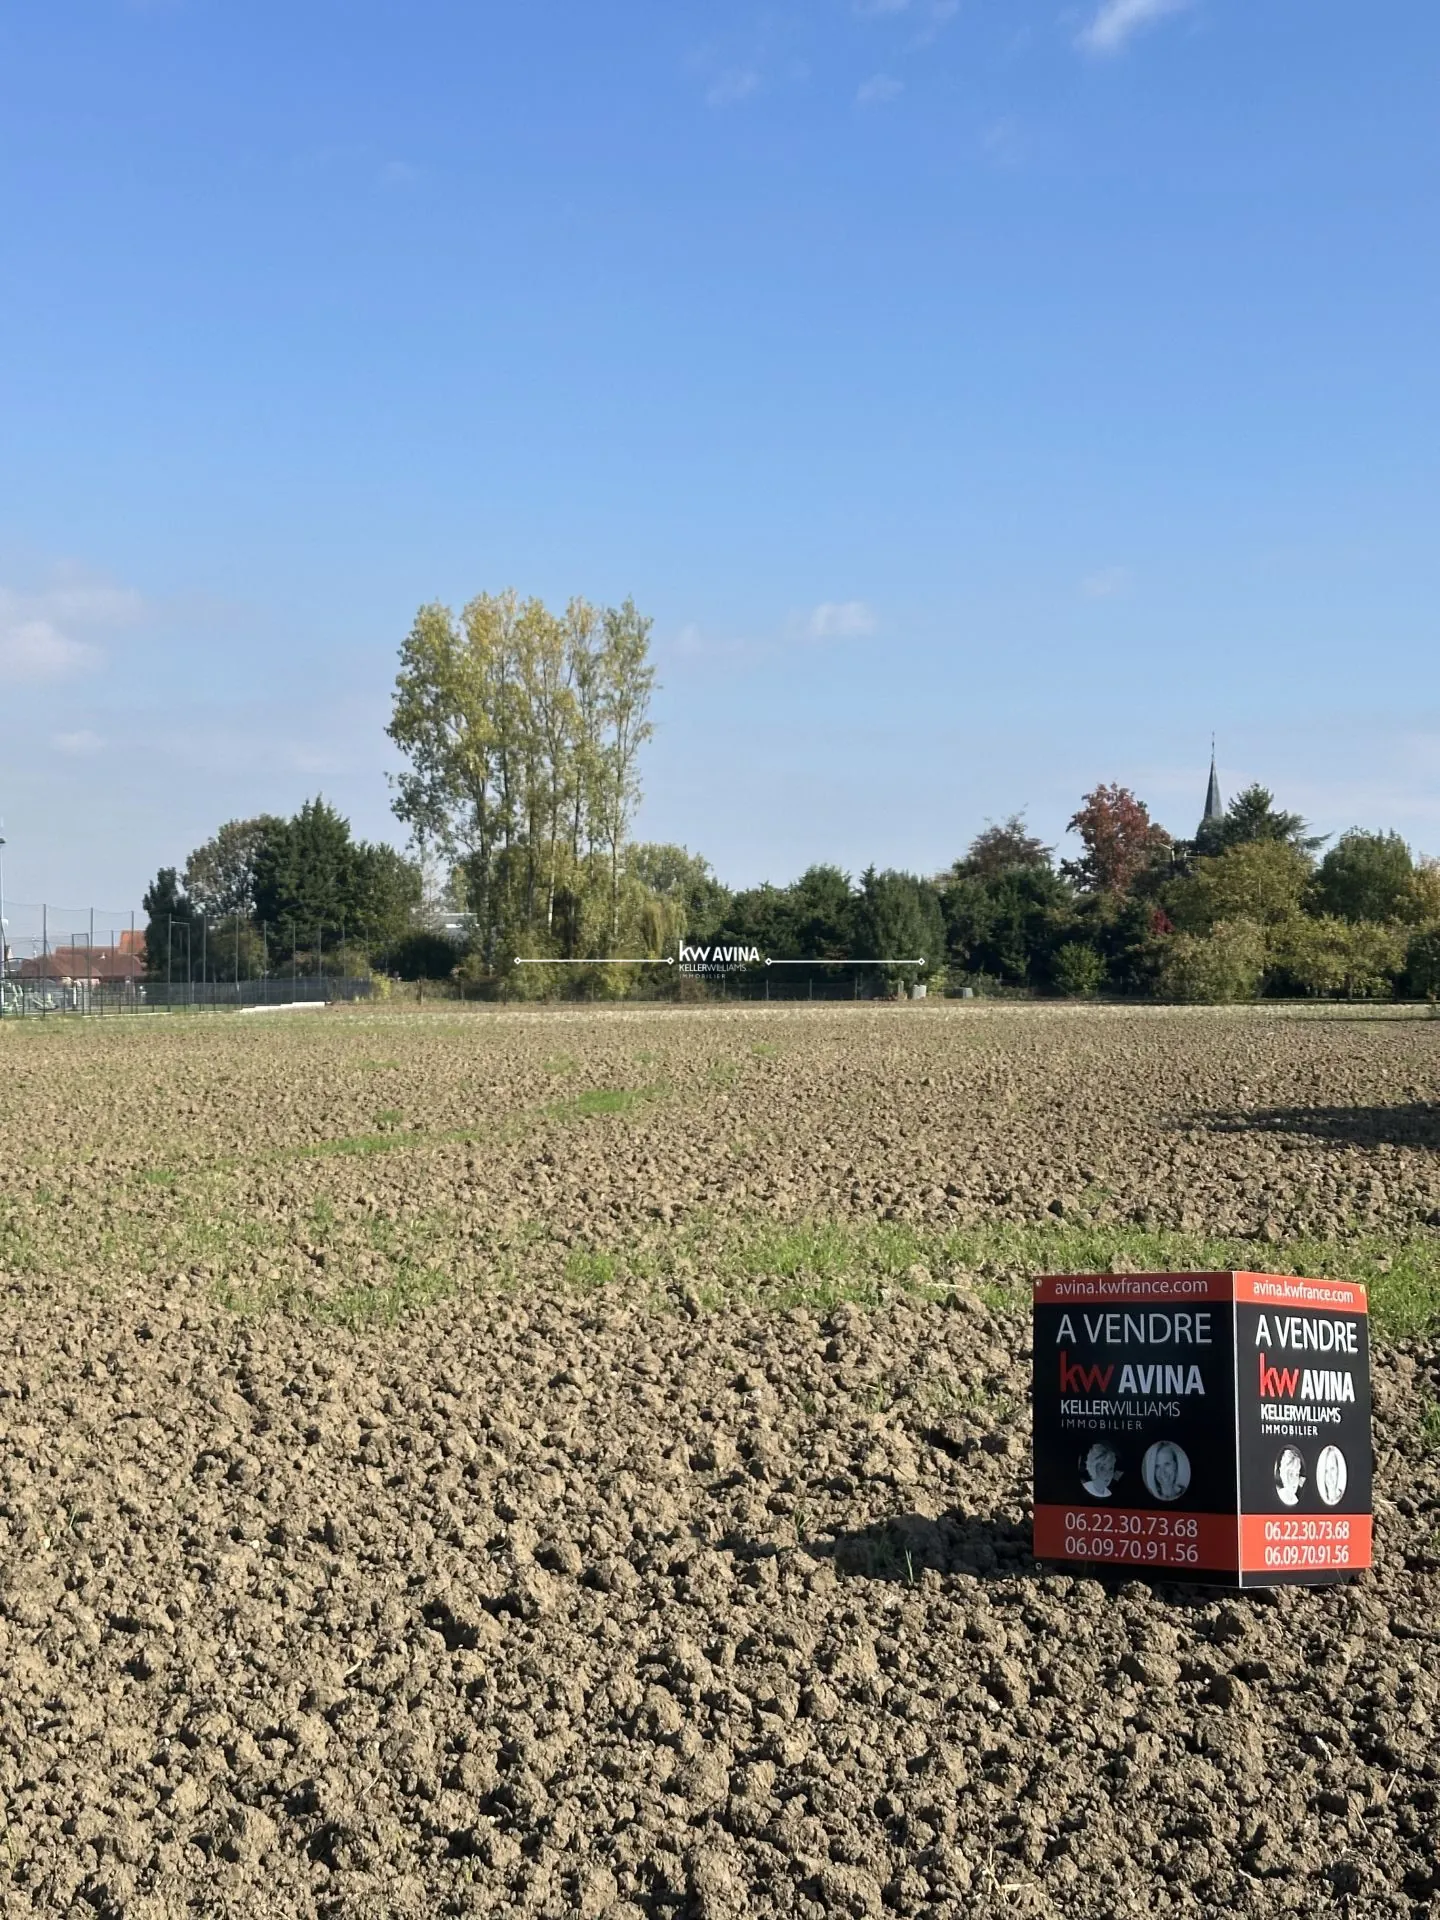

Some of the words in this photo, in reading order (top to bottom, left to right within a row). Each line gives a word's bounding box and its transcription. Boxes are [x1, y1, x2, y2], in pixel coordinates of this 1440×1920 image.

[1055, 1278, 1208, 1295] avina.kwfrance.com
[1253, 1280, 1354, 1304] avina.kwfrance.com
[1056, 1314, 1075, 1343] A
[1083, 1313, 1212, 1344] VENDRE
[1255, 1315, 1273, 1346] A
[1277, 1317, 1358, 1353] VENDRE
[1060, 1351, 1115, 1393] kw
[1118, 1364, 1205, 1395] AVINA
[1259, 1352, 1299, 1397] kw
[1301, 1370, 1355, 1402] AVINA
[1061, 1420, 1143, 1430] IMMOBILIER
[1261, 1424, 1318, 1436] IMMOBILIER
[1065, 1513, 1197, 1537] 06.22.30.73.68
[1265, 1521, 1350, 1540] 06.22.30.73.68
[1065, 1536, 1198, 1563] 06.09.70.91.56
[1265, 1545, 1349, 1565] 06.09.70.91.56
